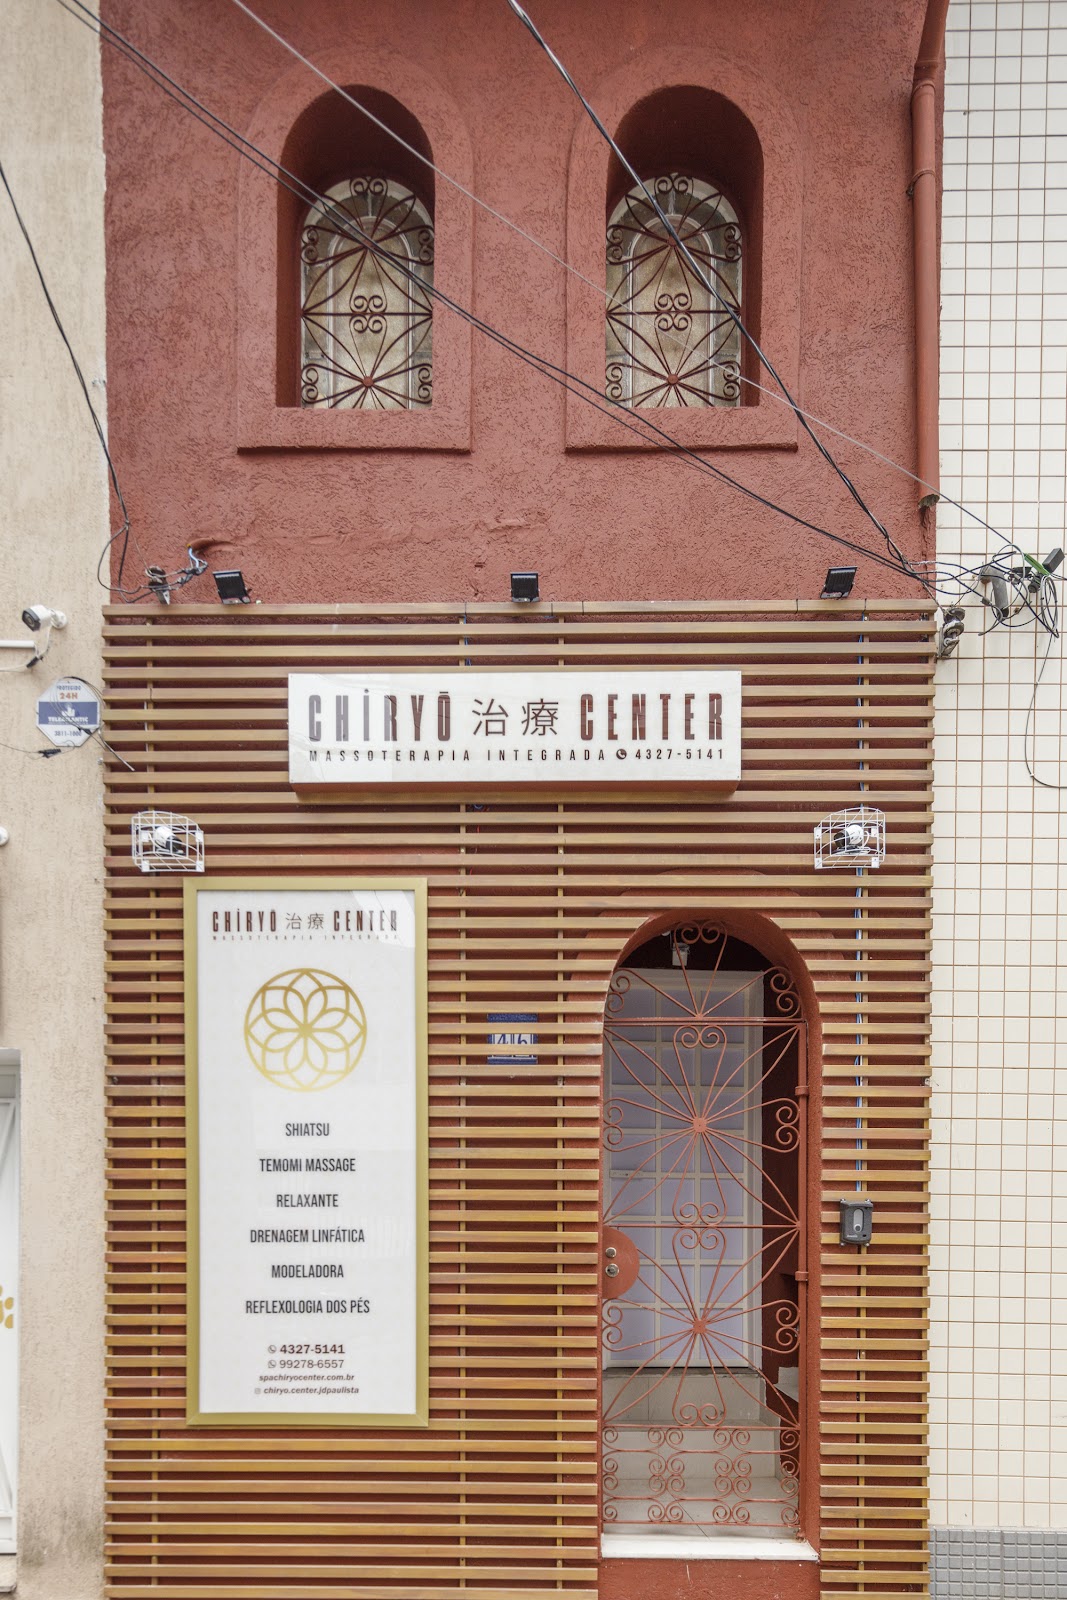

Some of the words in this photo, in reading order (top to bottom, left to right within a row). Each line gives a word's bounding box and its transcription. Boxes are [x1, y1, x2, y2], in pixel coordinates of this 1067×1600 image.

[580, 693, 723, 741] CENTER
[309, 750, 470, 762] MASSOTERAPIA
[487, 749, 605, 761] INTEGRADA
[634, 748, 723, 760] 4327-5141
[333, 910, 397, 931] CENTER
[285, 1123, 330, 1137] SHIATSU
[259, 1158, 302, 1172] TEMOMI
[305, 1158, 356, 1172] MASSAGE
[276, 1194, 339, 1208] RELAXANTE
[250, 1229, 309, 1243] DRENAGEM
[312, 1226, 365, 1243] LINFÁTICA
[271, 1265, 344, 1279] MODELADORA
[245, 1300, 323, 1314] REFLEXOLOGIA
[326, 1300, 347, 1314] DOS
[350, 1297, 370, 1314] PÉS
[279, 1344, 346, 1355] 4327-5141
[279, 1359, 345, 1369] 99278-6557
[259, 1373, 355, 1383] spachiryocenter.com.br
[263, 1386, 360, 1396] chiryo.center.jdpaulista
